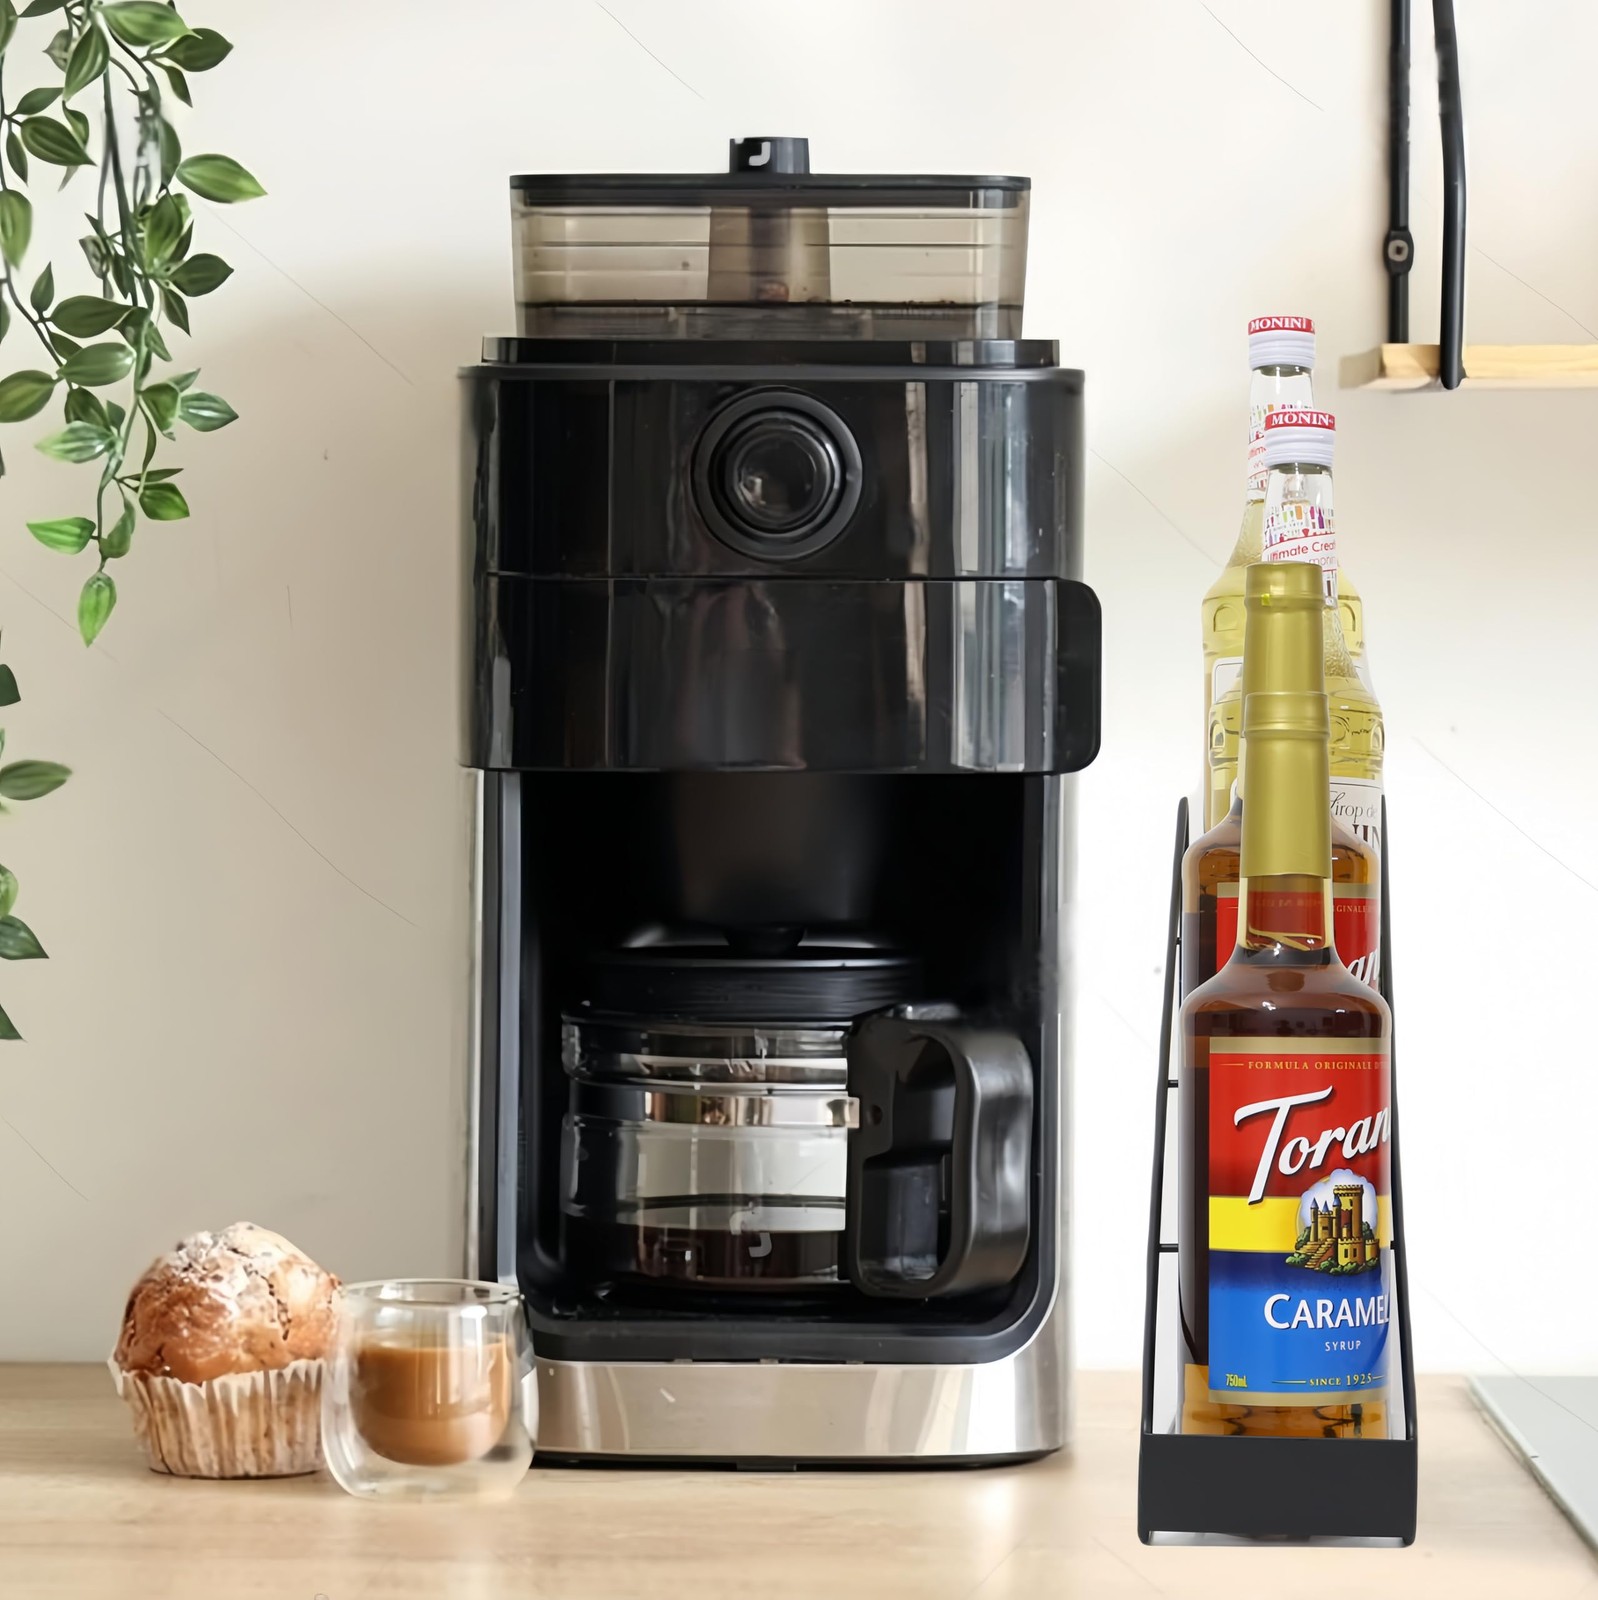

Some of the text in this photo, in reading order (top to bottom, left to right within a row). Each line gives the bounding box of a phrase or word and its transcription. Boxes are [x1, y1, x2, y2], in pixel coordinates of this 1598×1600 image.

[1250, 317, 1301, 332] MONIN
[1272, 412, 1329, 426] MONIN
[1248, 1061, 1309, 1070] FORMULA
[1314, 1061, 1373, 1070] ORIGINALE
[1264, 1293, 1390, 1330] CARAMEL
[1325, 1340, 1361, 1352] SYRUP
[1309, 1372, 1372, 1386] SINCE 1925
